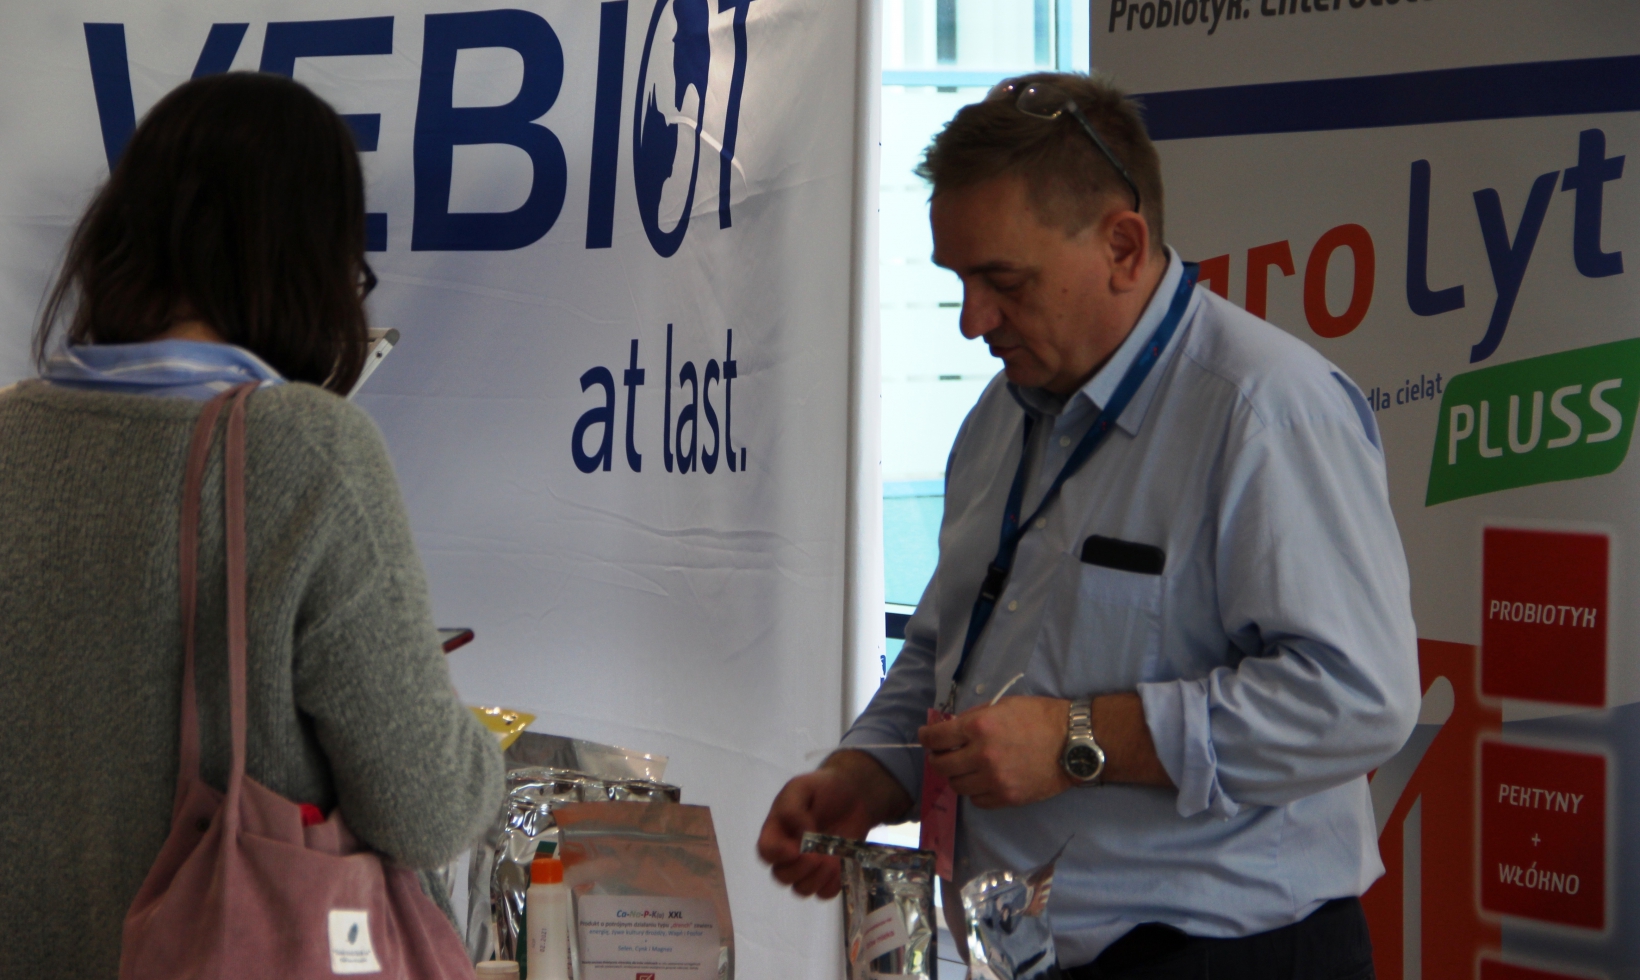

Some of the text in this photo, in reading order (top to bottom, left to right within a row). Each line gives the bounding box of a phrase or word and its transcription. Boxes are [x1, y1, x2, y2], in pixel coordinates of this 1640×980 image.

[571, 323, 747, 475] at last.
[1396, 373, 1443, 405] cieląt
[1448, 378, 1623, 465] PLUSS
[1489, 600, 1597, 628] PROBIOTYK
[1498, 783, 1585, 814] PEKTYNY
[1531, 833, 1541, 847] +
[1498, 861, 1580, 895] WŁÓKNO
[668, 911, 683, 919] XXL
